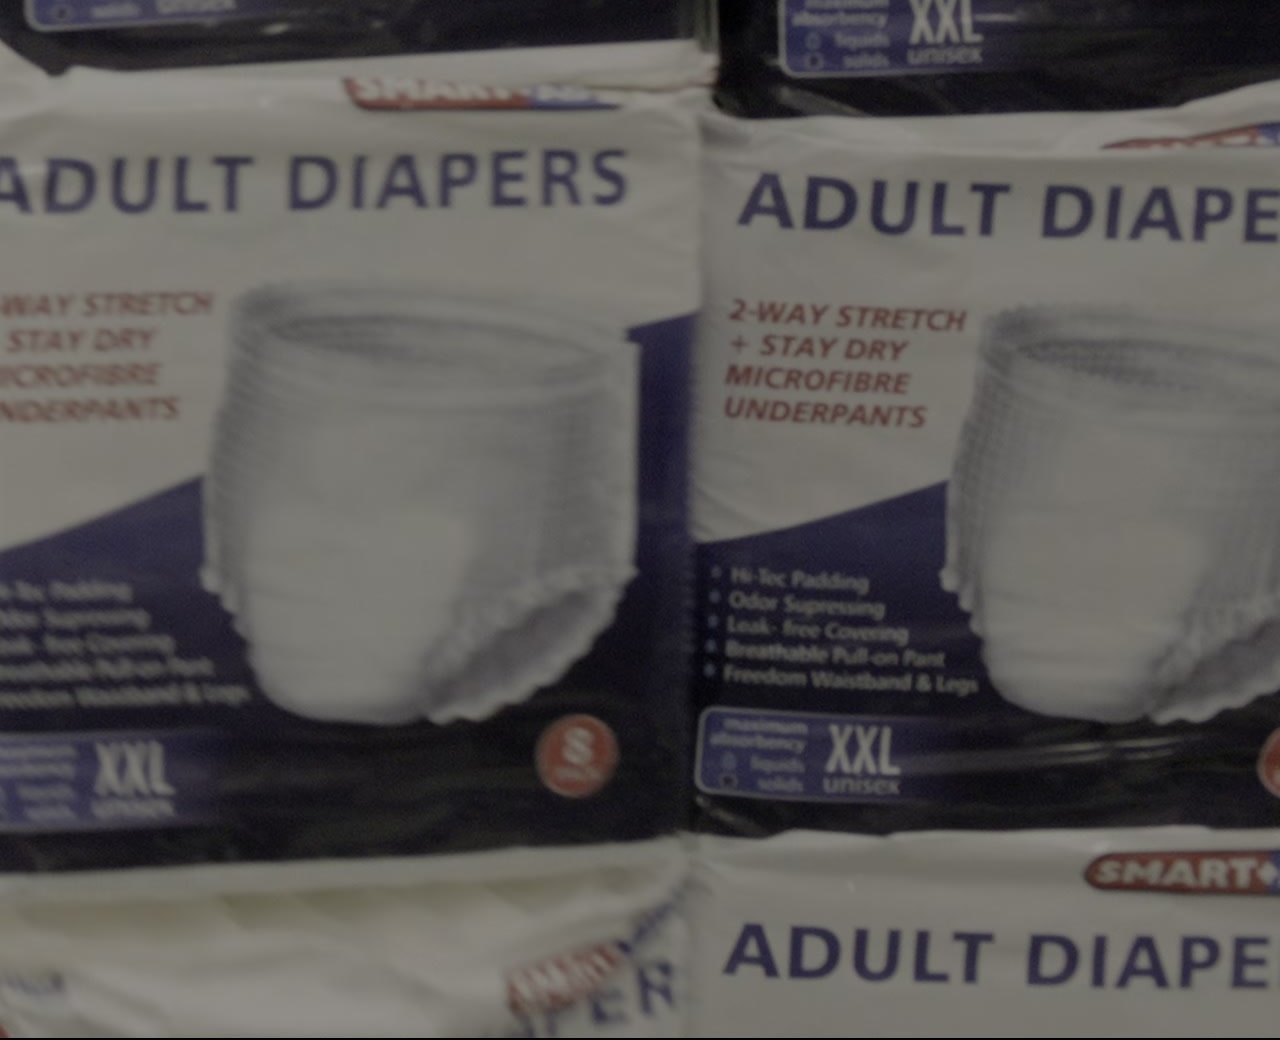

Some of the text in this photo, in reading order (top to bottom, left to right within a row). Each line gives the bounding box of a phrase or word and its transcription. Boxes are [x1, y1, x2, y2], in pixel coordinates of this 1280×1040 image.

[287, 147, 627, 211] DIAPERS
[738, 173, 1280, 244] ADULT DIAPE
[82, 291, 213, 317] STRETCH
[729, 300, 967, 333] 2-WAY STRETCH
[5, 328, 87, 354] STAY
[94, 327, 157, 352] DRY
[760, 336, 837, 361] STAY
[844, 339, 909, 362] DRY
[725, 365, 912, 396] MICROFIBRE
[724, 399, 928, 430] UNDERPANTS
[791, 570, 869, 596] Padding
[728, 591, 778, 611] Odor
[782, 620, 821, 639] free
[824, 622, 909, 647] Covering
[725, 639, 829, 664] Breathable
[902, 649, 945, 668] Pant
[723, 663, 980, 696] Freedom Waistband & Legs
[826, 723, 902, 776] XXL
[93, 740, 177, 797] XXL
[823, 776, 901, 796] unisex
[723, 923, 1268, 990] ADULT DIAPE
